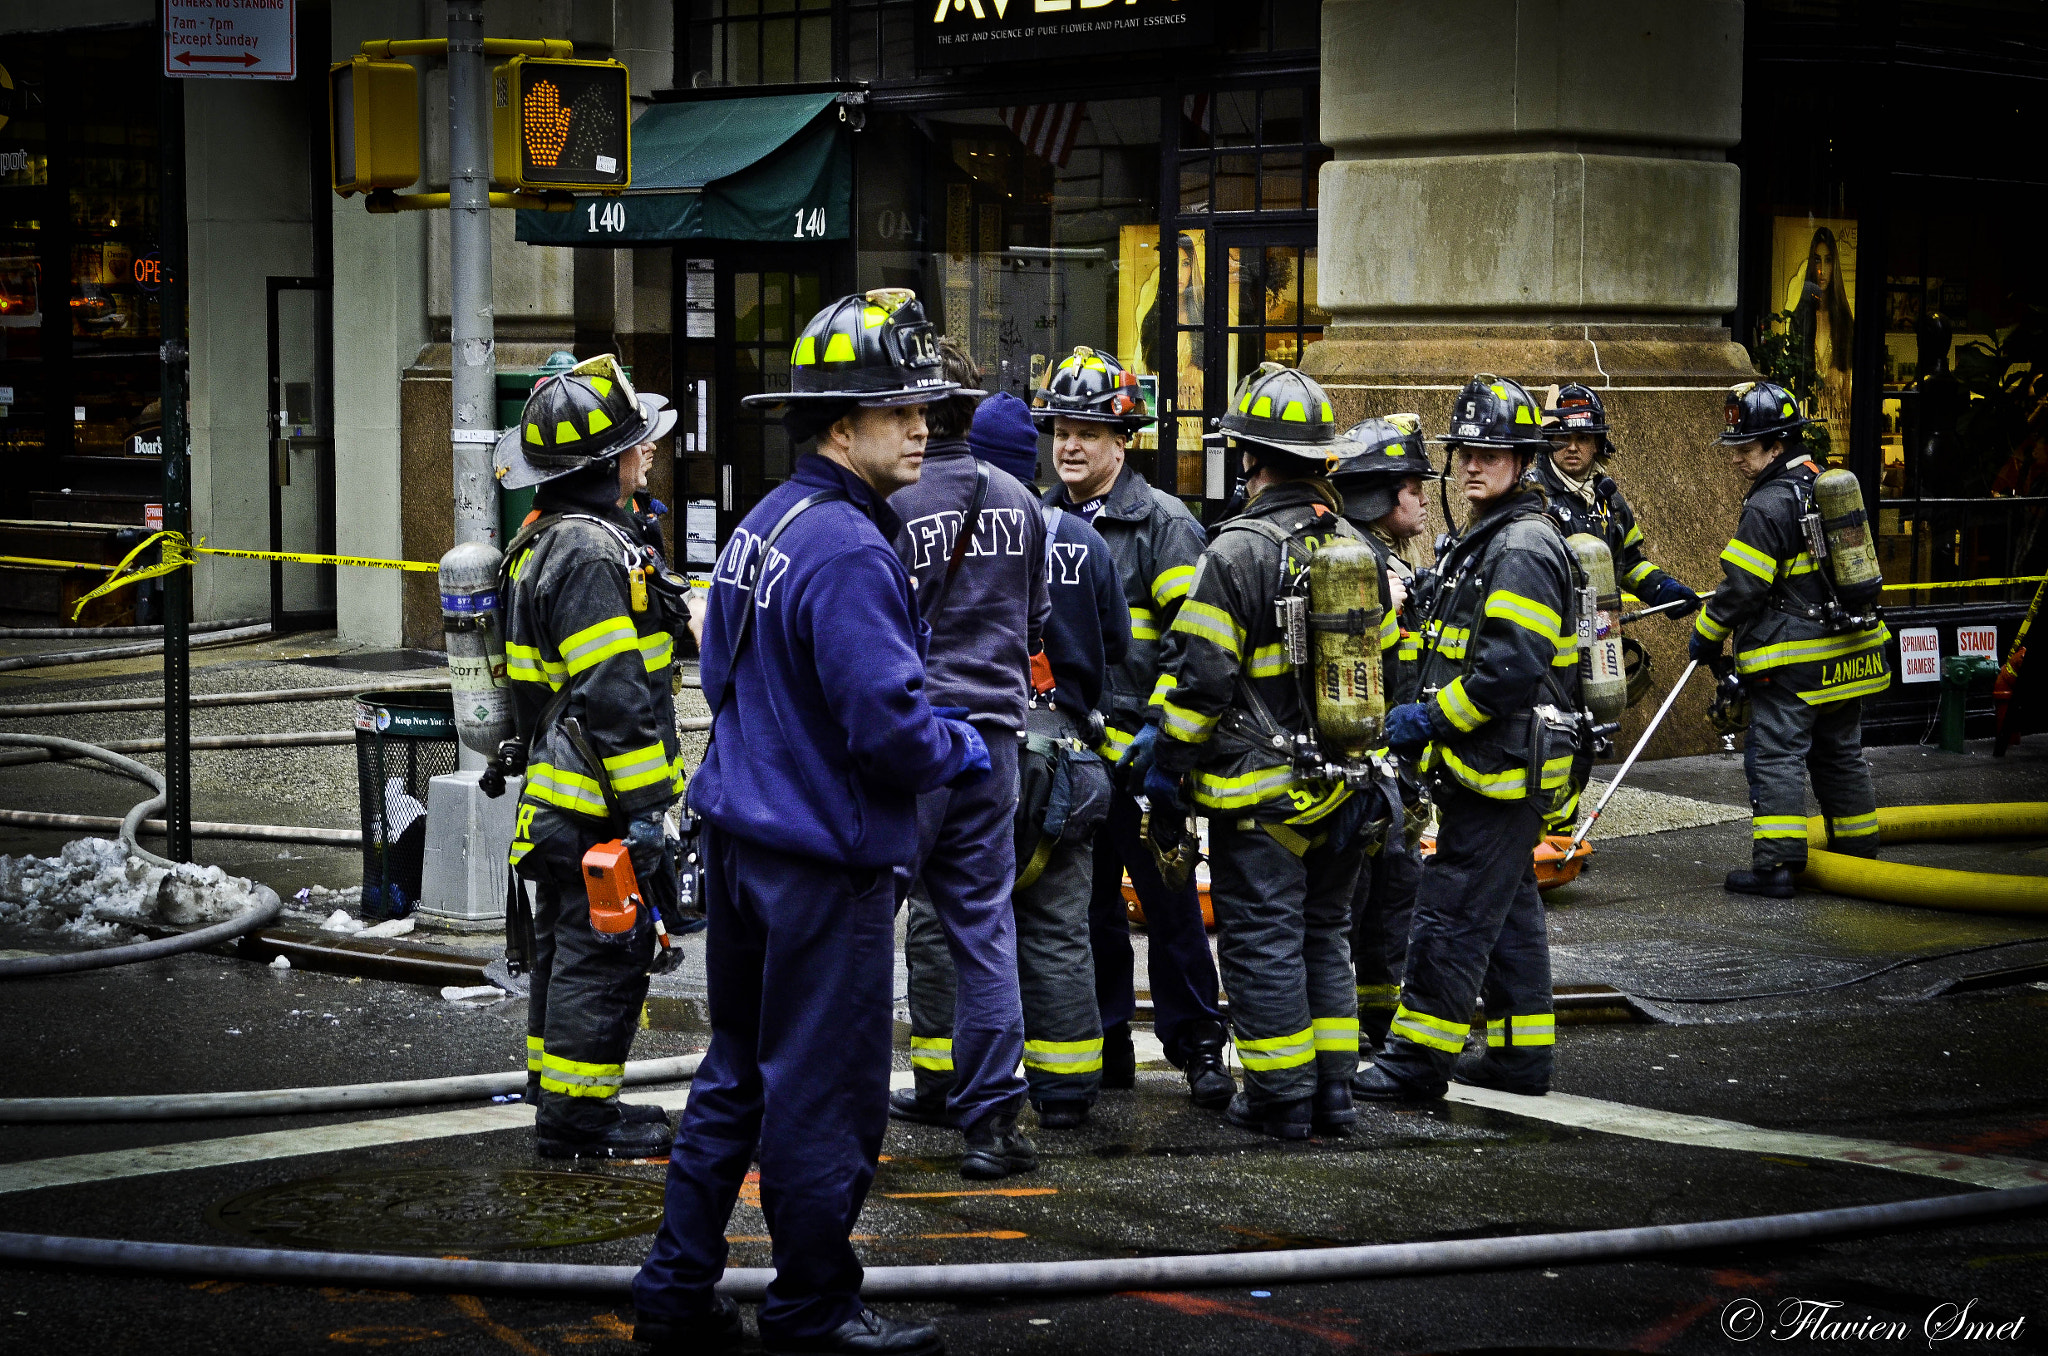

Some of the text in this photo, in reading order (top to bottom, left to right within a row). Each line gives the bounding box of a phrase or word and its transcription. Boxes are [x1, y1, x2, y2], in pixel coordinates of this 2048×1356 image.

[172, 0, 285, 10] OTHERS NO STANDING
[172, 16, 197, 30] 7am
[208, 17, 234, 32] 7pm
[938, 13, 1187, 45] THE ART AND SCIENCE OF PURE FLOWER AND PLANT ESSENCES
[172, 32, 259, 49] Except Sunday
[587, 201, 626, 233] 140
[793, 206, 826, 238] 140
[134, 258, 172, 284] OPE
[911, 332, 936, 360] 16
[1465, 401, 1476, 420] 5
[134, 436, 162, 455] Boar's
[907, 508, 1025, 570] FDNY
[711, 527, 791, 609] DNY
[1047, 543, 1088, 584] Y
[1901, 634, 1938, 653] SPRINKLER
[1959, 631, 1995, 651] STAND
[1605, 641, 1619, 677] SCOTT
[1821, 652, 1884, 687] LANIGAN
[1906, 657, 1936, 676] SIAMESE
[1326, 661, 1341, 702] SCOTT
[1353, 660, 1369, 701] SCOTT
[395, 716, 412, 727] Keep
[413, 716, 428, 726] New
